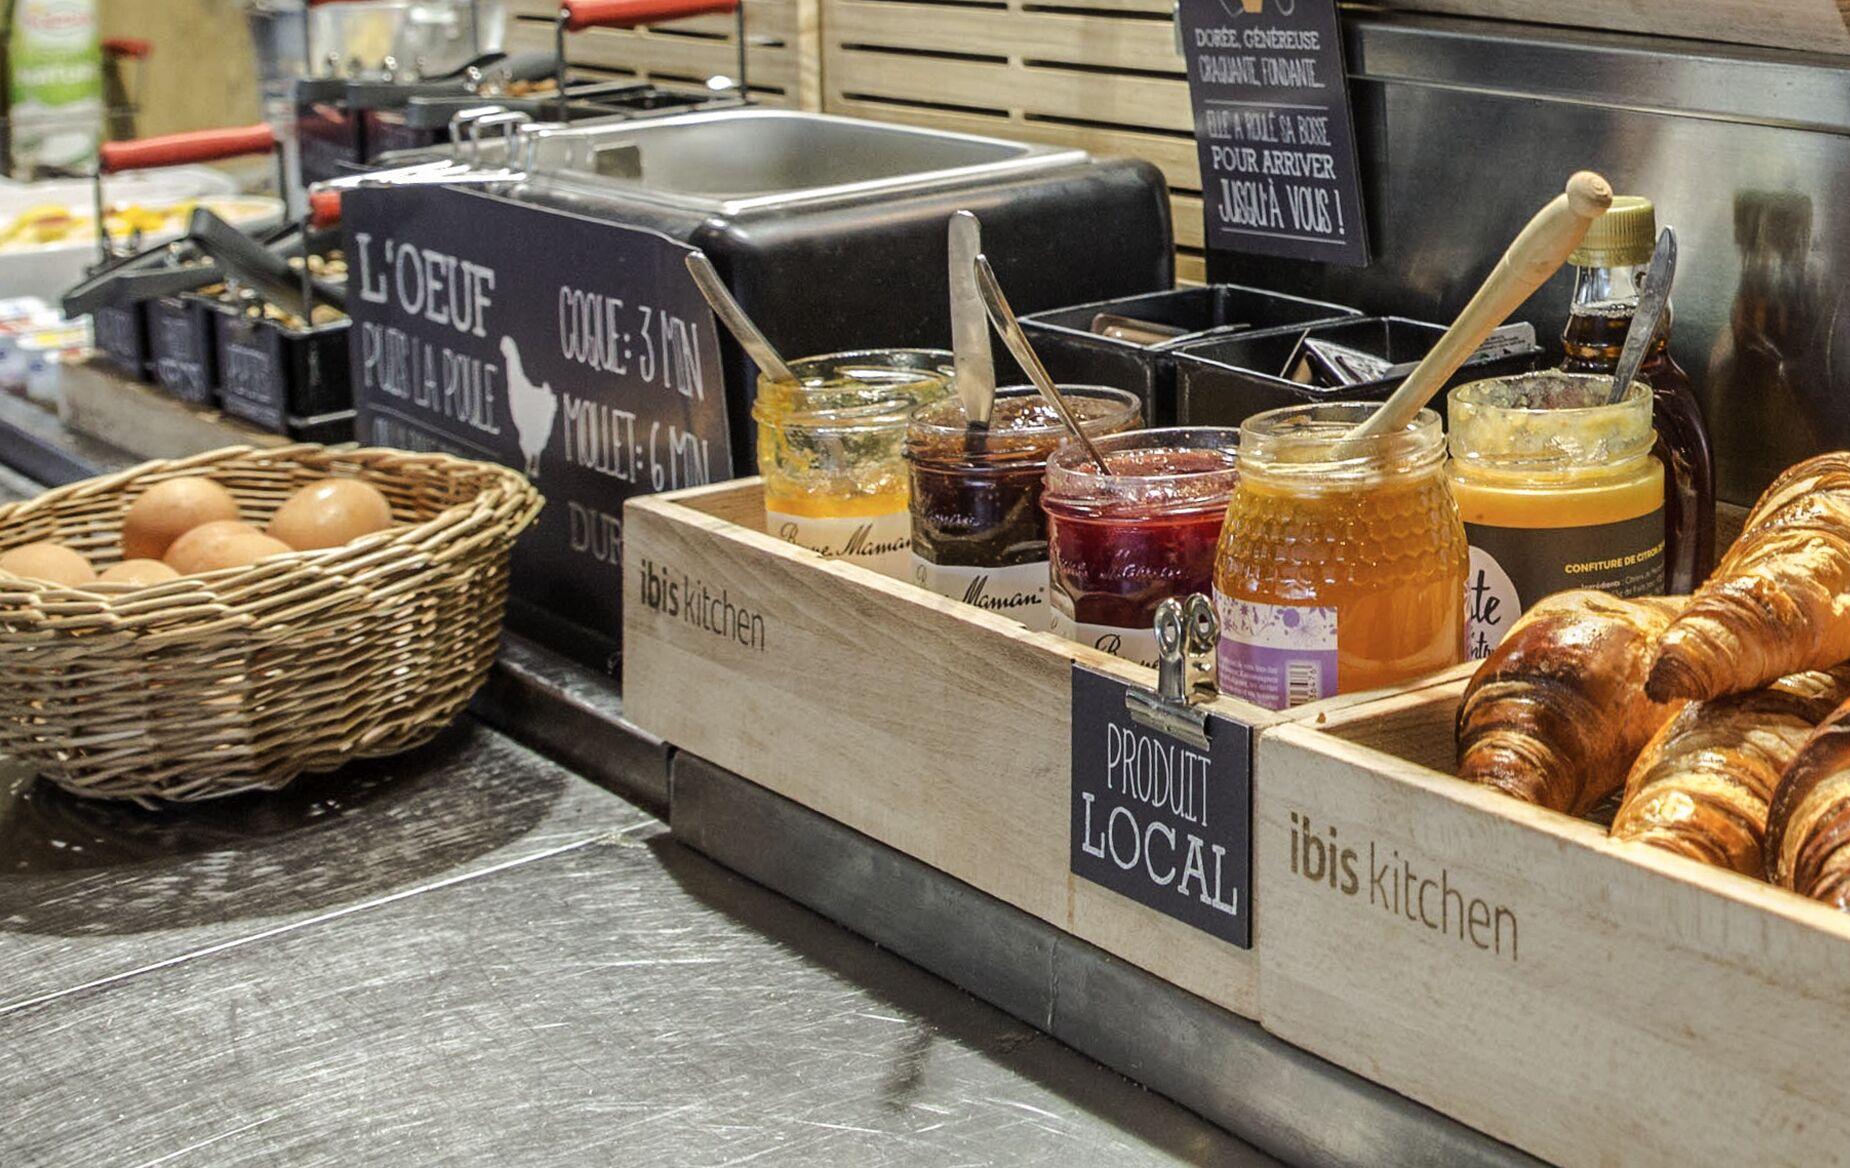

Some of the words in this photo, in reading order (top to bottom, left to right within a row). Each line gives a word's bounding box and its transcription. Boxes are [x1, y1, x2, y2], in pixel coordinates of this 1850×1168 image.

[1243, 26, 1321, 51] GÉNÉREUSE
[1211, 146, 1259, 173] POUR
[1262, 149, 1336, 180] ARRIVER
[1285, 184, 1332, 234] VOUS
[356, 232, 495, 338] L'OEUF
[559, 285, 631, 376] COQUE:
[639, 305, 656, 383] 3
[660, 309, 704, 401] MIN
[650, 421, 664, 492] 6
[640, 560, 679, 617] ibis
[684, 575, 765, 652] kitchen
[1564, 557, 1623, 574] CONFITURE
[1624, 553, 1636, 567] DE
[1106, 722, 1211, 827] PRODUIT
[1082, 791, 1238, 916] LOCAL
[1288, 811, 1359, 896] ibis
[1369, 840, 1519, 961] kitchen
